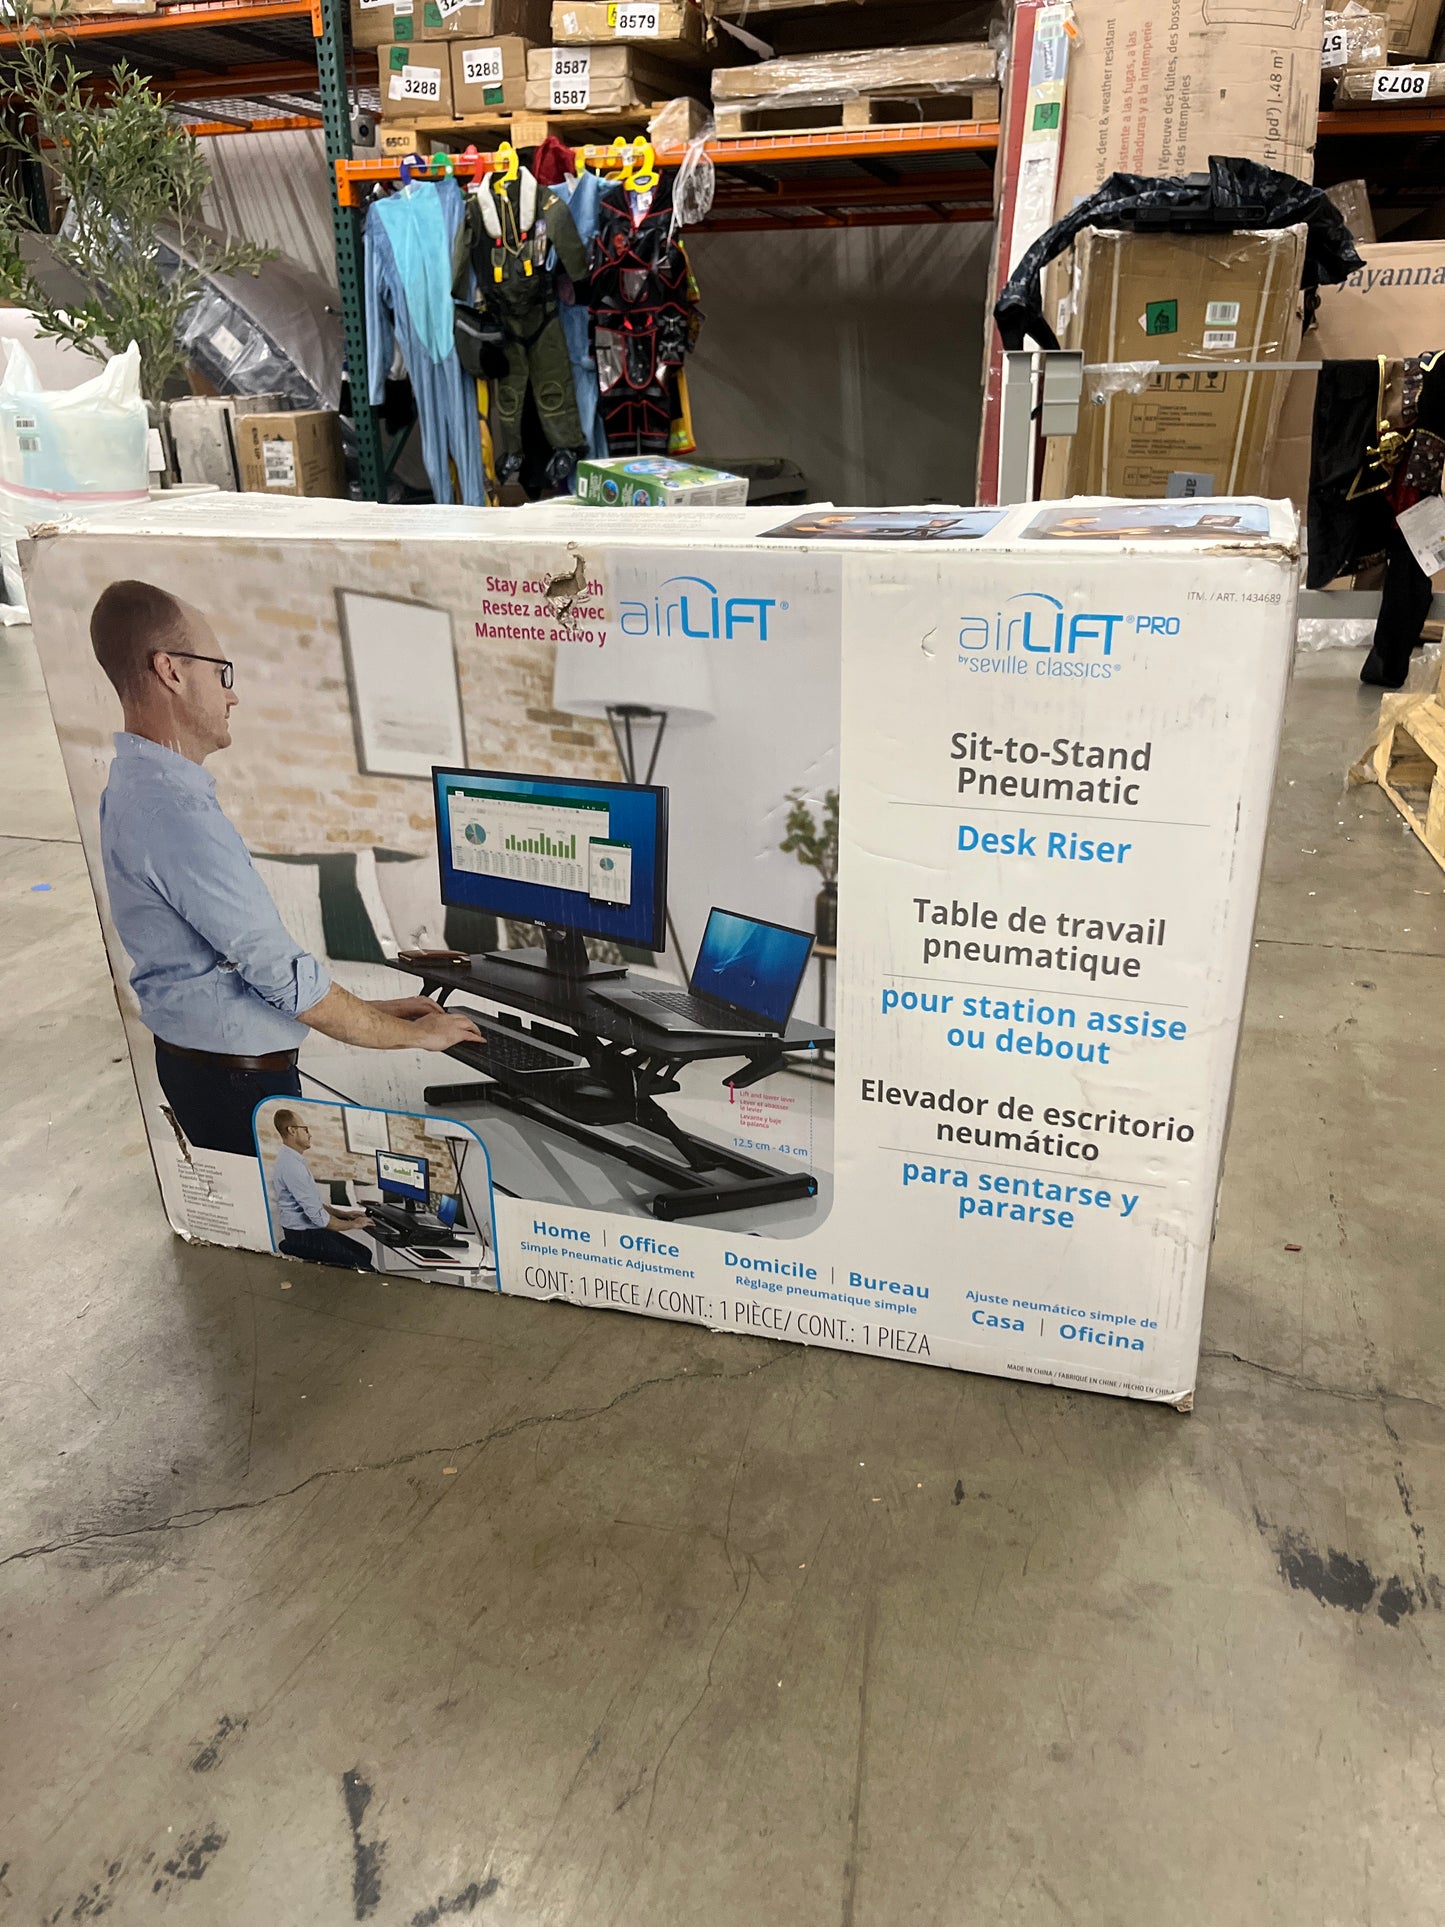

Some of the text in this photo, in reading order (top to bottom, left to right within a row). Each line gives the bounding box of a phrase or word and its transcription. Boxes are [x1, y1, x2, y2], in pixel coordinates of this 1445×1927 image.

[620, 15, 655, 29] 8579
[1103, 18, 1116, 66] resistant
[1126, 30, 1138, 48] las
[1138, 21, 1153, 81] intemperie
[1168, 33, 1179, 53] des
[467, 62, 500, 78] 3288
[555, 60, 587, 75] 8587
[1123, 59, 1137, 94] fugas,
[1165, 56, 1178, 92] fuites,
[404, 79, 437, 95] 3288
[553, 90, 586, 105] 8587
[1100, 69, 1113, 114] weather
[1136, 84, 1148, 95] la
[1377, 76, 1425, 93] 8073
[1121, 96, 1134, 113] las
[1162, 94, 1175, 114] des
[1176, 74, 1192, 143] intempéries
[1100, 116, 1109, 126] &
[1097, 129, 1109, 154] dent
[1174, 145, 1186, 166] des
[1336, 266, 1445, 294] ayanna
[486, 577, 518, 596] Stay
[1216, 592, 1239, 603] ART.
[1241, 593, 1282, 604] 1434689
[482, 600, 530, 617] Restez
[571, 606, 605, 620] avec
[475, 622, 607, 648] Mantente activo y
[1135, 615, 1180, 636] PRO
[958, 654, 969, 666] by
[969, 656, 1028, 676] seville
[949, 732, 1152, 772] Sit-to-Stand
[957, 766, 1141, 806] Pneumatic
[957, 825, 1132, 864] Desk Riser
[912, 898, 1166, 946] Table de travail
[923, 937, 1141, 982] pneumatique
[881, 987, 1188, 1041] pour station assise
[947, 1027, 1111, 1065] ou debout
[861, 1078, 1195, 1143] Elevador de escritorio
[733, 1137, 753, 1149] 12.5
[755, 1142, 770, 1151] cm
[778, 1144, 791, 1154] 43
[793, 1147, 808, 1157] cm
[936, 1122, 1099, 1161] neumático
[902, 1162, 1139, 1218] para sentarse y
[958, 1194, 1074, 1228] pararse
[533, 1220, 680, 1257] Home Office
[520, 1241, 695, 1279] Simple Pneumatic Adjustment
[724, 1251, 930, 1299] Domicile Bureau
[786, 1285, 871, 1307] pneumatique
[875, 1298, 918, 1315] simple
[965, 1290, 1158, 1329] Ajuste neumático simple de
[580, 1276, 587, 1296] 1
[595, 1278, 640, 1306] PIECE
[658, 1289, 713, 1319] CONT.:
[719, 1301, 728, 1320] 1
[797, 1313, 855, 1343] CONT.:
[863, 1325, 870, 1345] 1
[878, 1327, 931, 1356] PIEZA
[971, 1309, 1145, 1352] Casa Oficina
[1007, 1363, 1024, 1372] MADE
[1025, 1366, 1033, 1374] IN
[1033, 1368, 1053, 1377] CHINA
[1089, 1376, 1098, 1385] EN
[1099, 1378, 1117, 1388] CHINE
[1123, 1383, 1145, 1392] HECHO
